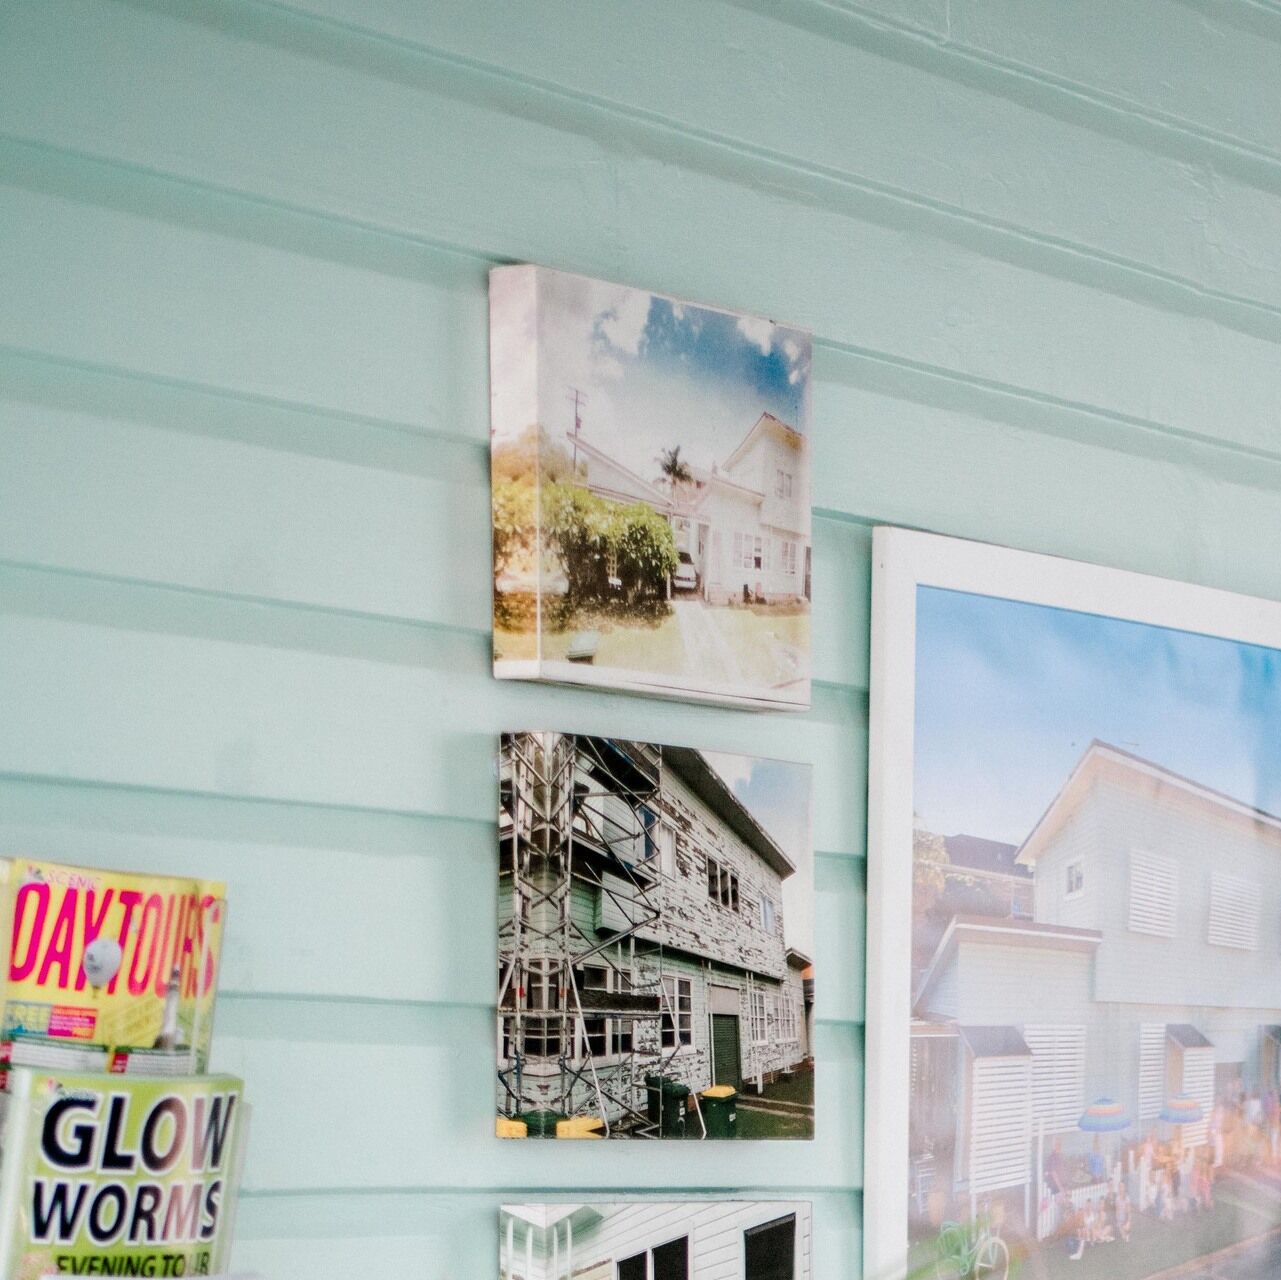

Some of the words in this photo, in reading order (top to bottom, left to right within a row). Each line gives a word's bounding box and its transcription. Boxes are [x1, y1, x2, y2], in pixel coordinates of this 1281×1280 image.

[42, 1096, 235, 1170] GLOW
[33, 1181, 222, 1239] WORMS
[57, 1254, 156, 1278] EVENING
